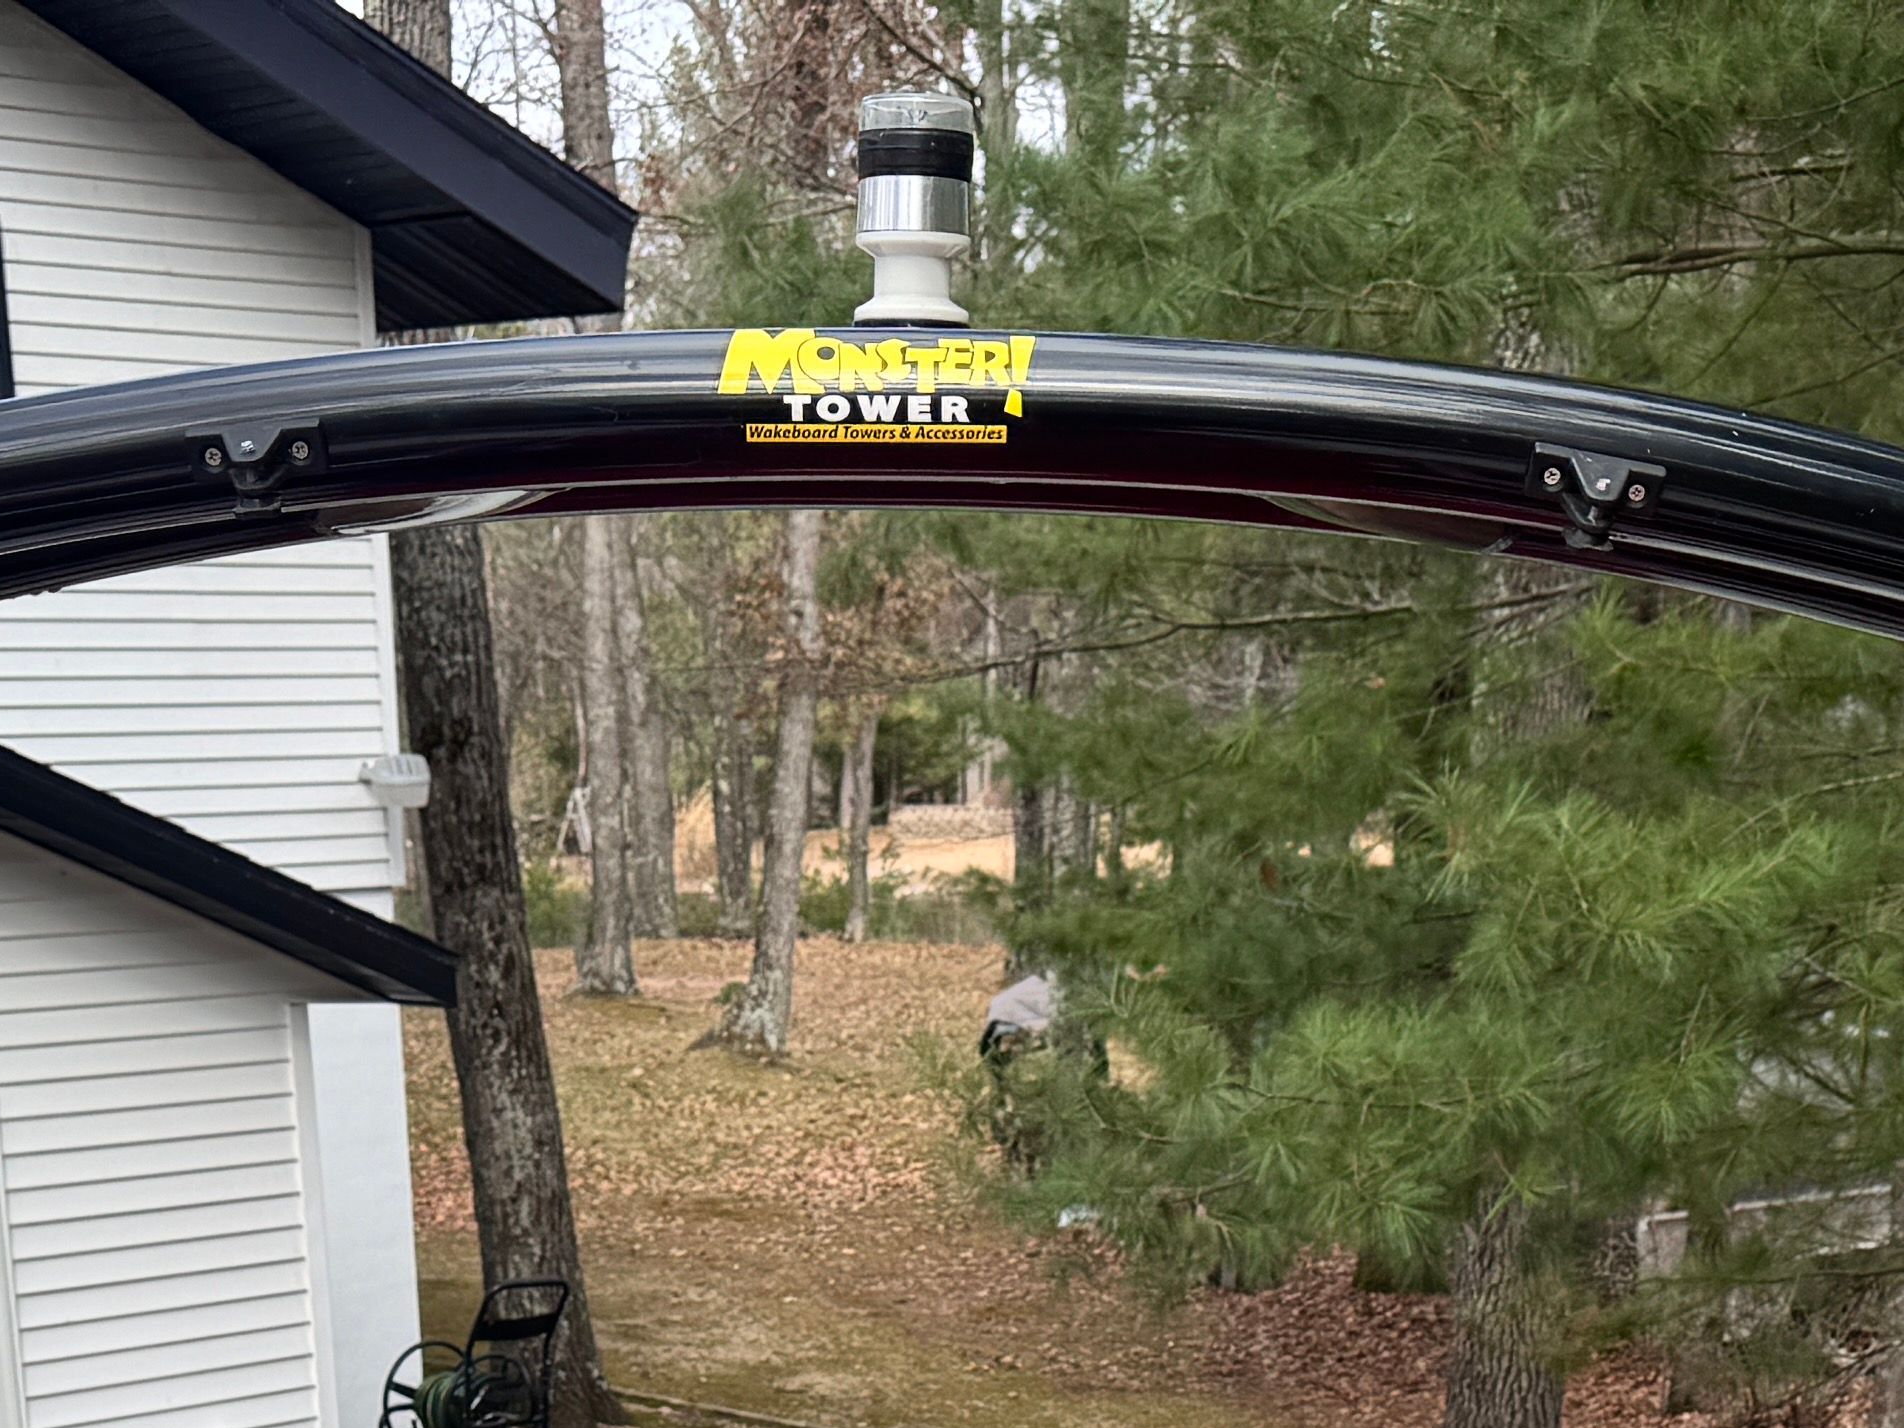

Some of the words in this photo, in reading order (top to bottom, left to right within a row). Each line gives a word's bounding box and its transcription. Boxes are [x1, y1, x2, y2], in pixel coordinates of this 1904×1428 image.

[717, 328, 1036, 417] MONSTER!
[783, 395, 970, 422] TOWER
[749, 426, 838, 439] Wakeboard
[843, 426, 896, 439] Towers
[899, 426, 911, 439] &
[915, 426, 1003, 441] Accessories
